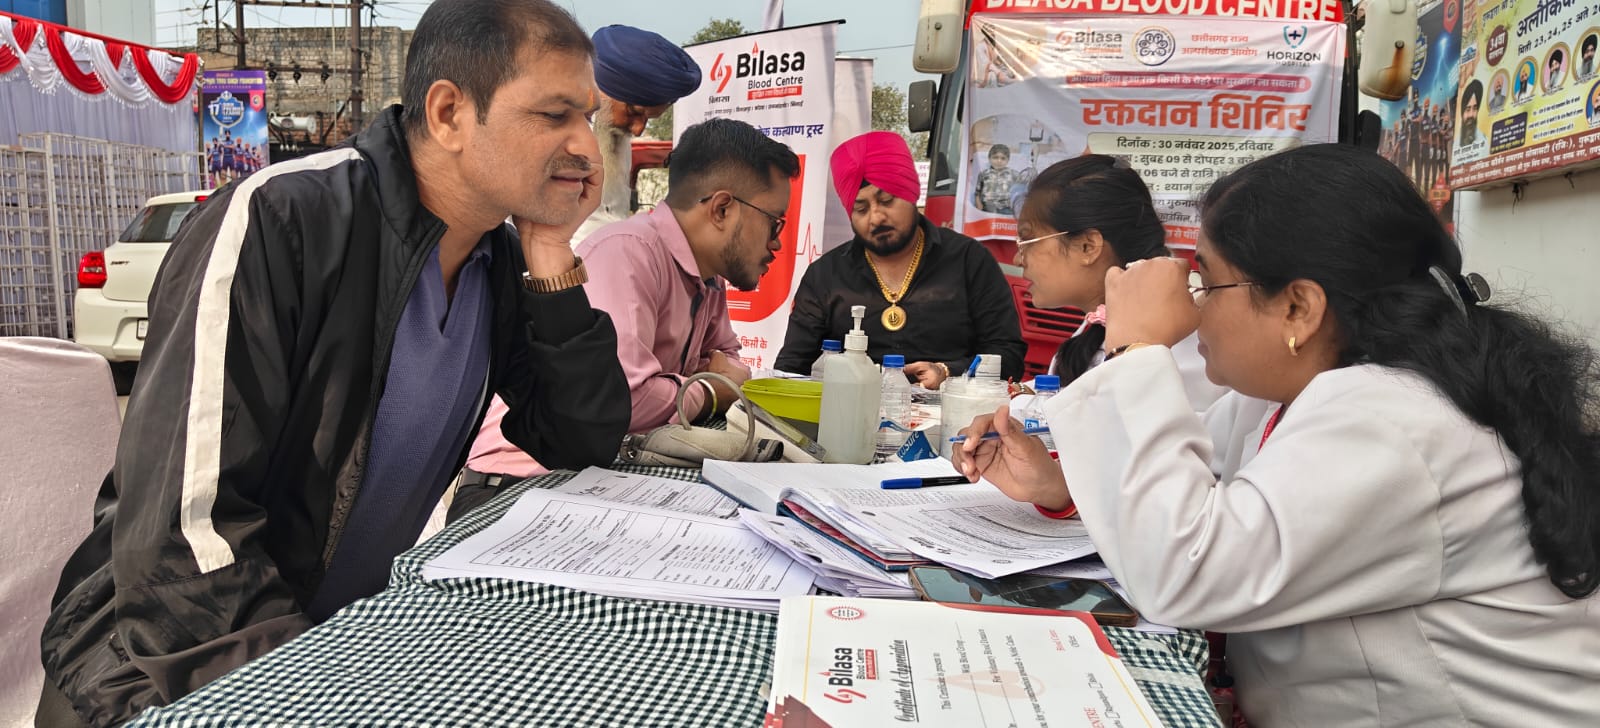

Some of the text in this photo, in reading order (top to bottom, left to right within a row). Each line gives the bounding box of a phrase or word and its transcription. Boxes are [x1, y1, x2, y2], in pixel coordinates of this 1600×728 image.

[1215, 0, 1337, 21] CENTRE
[736, 47, 805, 78] Bilasa
[1267, 51, 1321, 61] HORIZON
[748, 75, 803, 90] Blood Centre
[1080, 93, 1312, 131] रक्तदान शिविर
[772, 125, 804, 138] कल्याण
[806, 124, 824, 139] ट्रस्ट
[1158, 140, 1173, 149] 30
[1140, 154, 1165, 166] सुबह
[1166, 155, 1180, 163] 09
[1182, 153, 1192, 164] से
[1194, 153, 1225, 166] दोपहर
[1143, 169, 1158, 177] 06
[1160, 167, 1178, 177] बजे
[1180, 168, 1190, 177] से
[1192, 167, 1214, 178] रात्रि
[1165, 183, 1192, 192] श्याम
[981, 644, 994, 655] Blood
[958, 651, 970, 663] Blood
[826, 647, 853, 687] Bilasa
[855, 648, 866, 680] Blood Centre
[961, 663, 970, 674] With
[888, 639, 916, 722] Certificate of Appreciation
[991, 675, 1003, 684] For
[937, 677, 950, 700] Certificate
[940, 700, 952, 710] This
